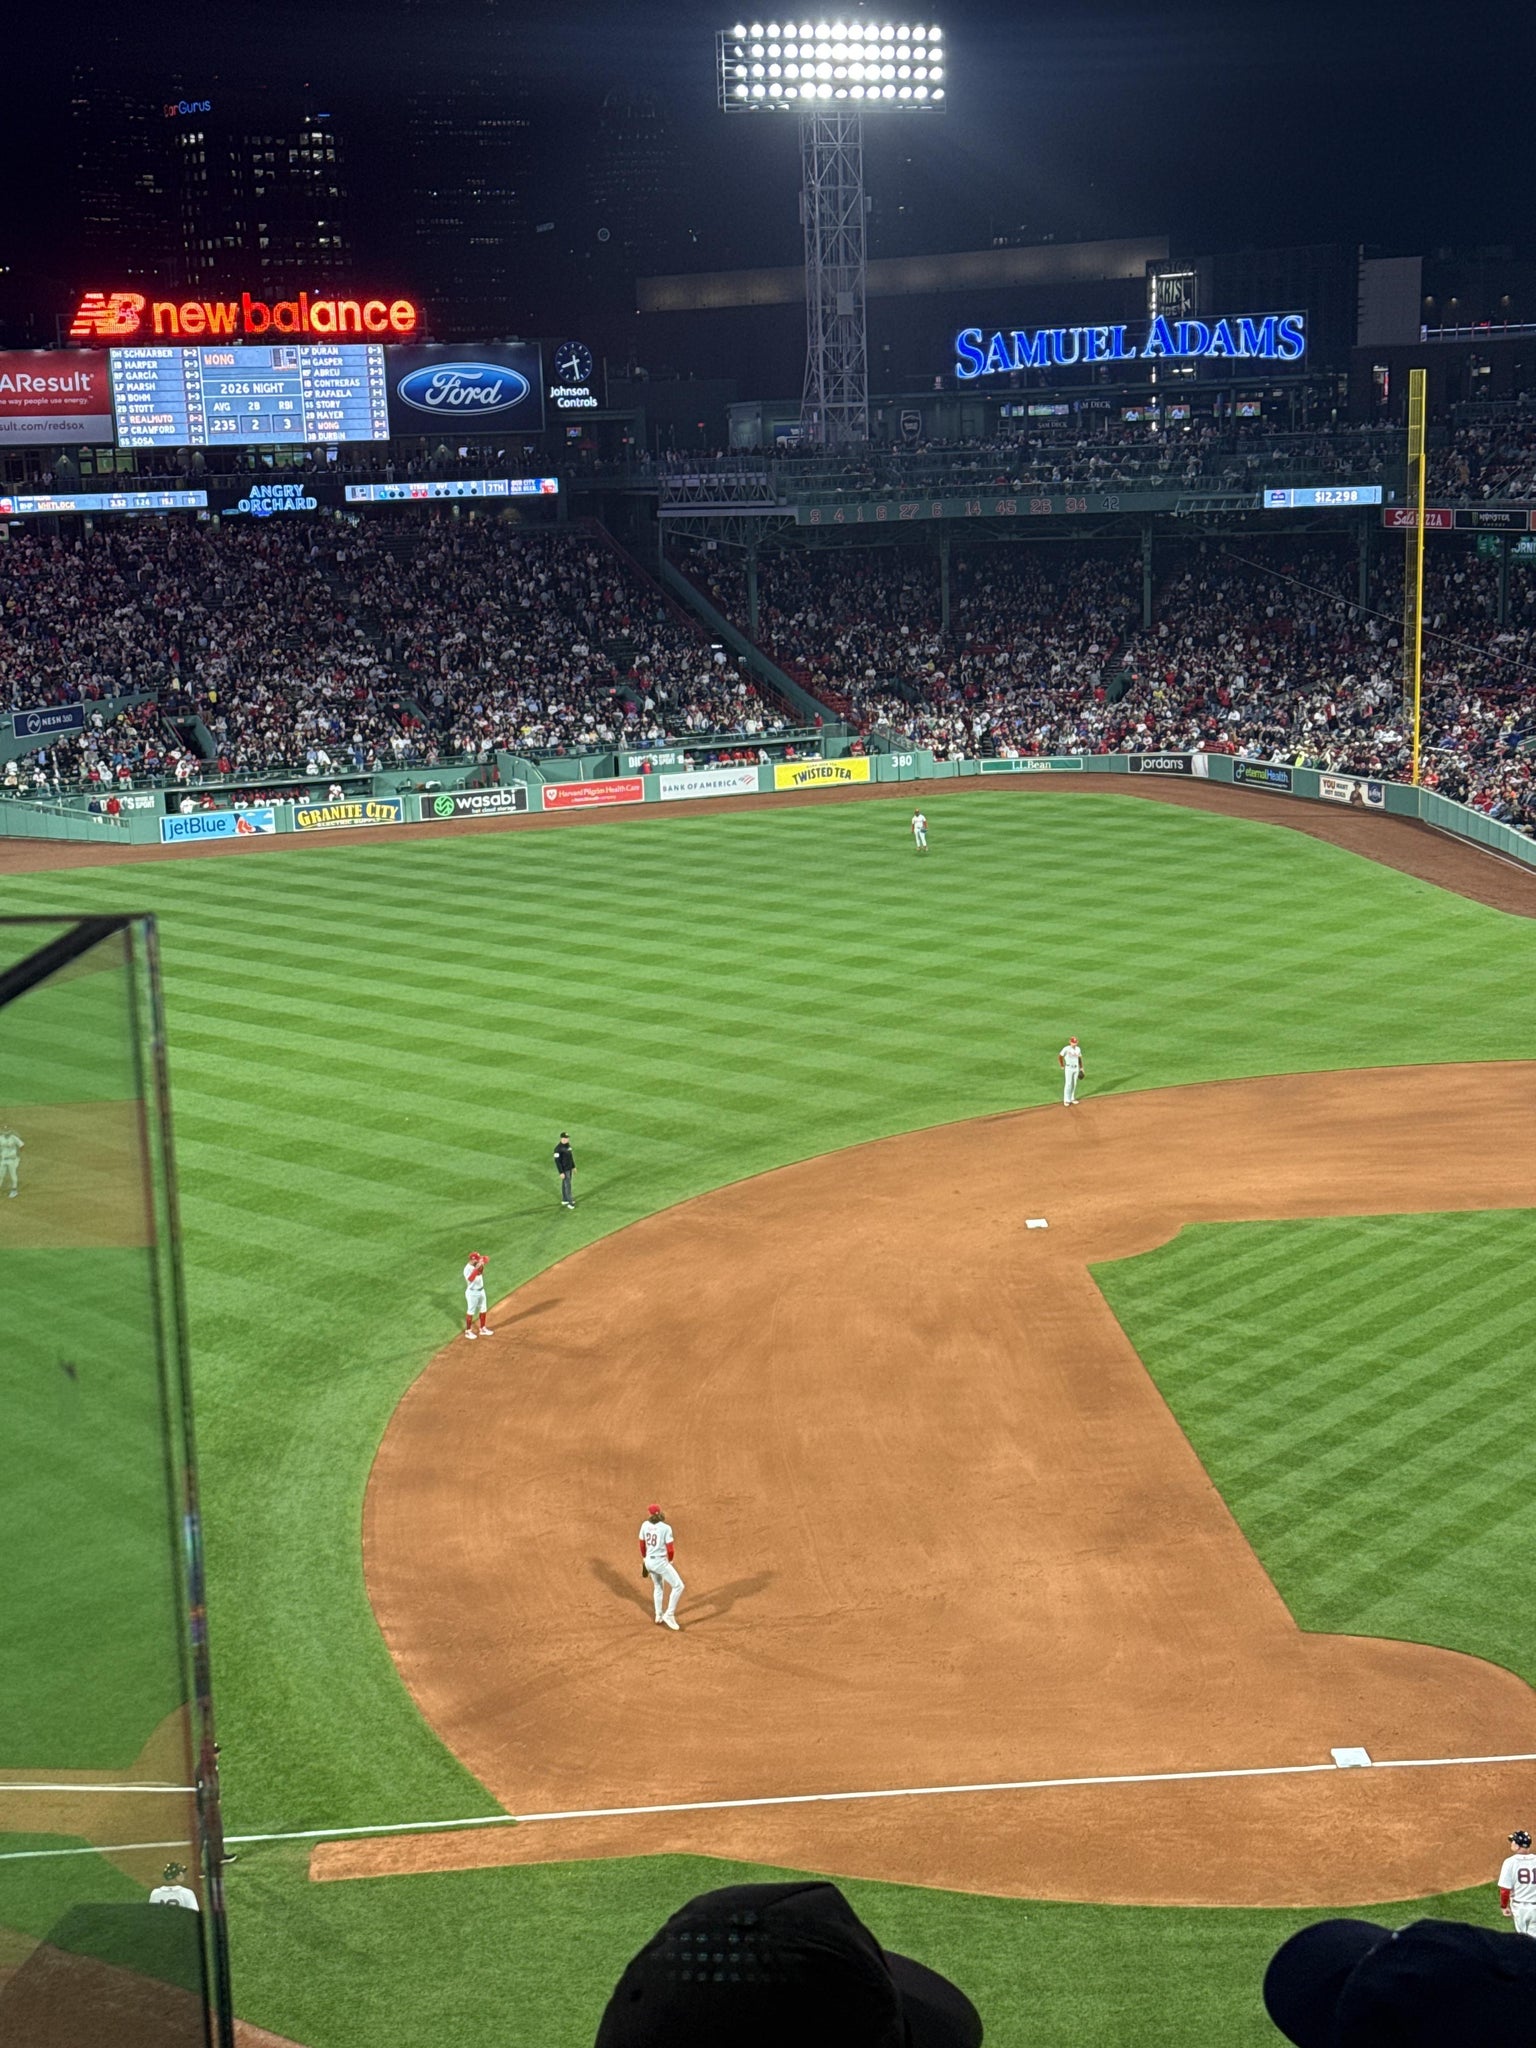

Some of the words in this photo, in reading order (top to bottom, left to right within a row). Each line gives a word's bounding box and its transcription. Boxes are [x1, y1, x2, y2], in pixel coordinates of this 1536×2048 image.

[164, 100, 211, 118] CarGurus
[153, 302, 238, 334] new
[242, 292, 415, 332] balance
[956, 326, 1137, 379] SAMUEL
[1141, 315, 1304, 361] ADAMS
[124, 350, 173, 358] SCHWARBER
[204, 354, 235, 365] WONG
[125, 361, 158, 369] HARPER
[312, 358, 343, 366] GASPER
[126, 370, 158, 380] GARCÍA
[127, 382, 155, 391] MARSH
[220, 383, 250, 394] 2026
[253, 382, 284, 393] NIGHT
[314, 379, 360, 387] CONTRERAS
[425, 371, 503, 405] Ford
[550, 386, 589, 398] Johnson
[24, 398, 48, 406] people
[213, 402, 231, 411] AVG
[248, 401, 260, 411] 2B
[279, 400, 293, 410] RBI
[557, 396, 598, 408] Controls
[129, 404, 154, 413] STOTT
[130, 415, 173, 423] REALMUTO
[316, 411, 344, 419] MAYER
[131, 426, 175, 434] CRAWFORD
[210, 419, 236, 431] .235
[252, 419, 259, 430] 2
[284, 419, 291, 429] 3
[318, 421, 339, 430] WONG
[132, 437, 154, 445] SOSA
[249, 484, 304, 498] ANGRY
[488, 484, 504, 492] 7TH
[1314, 490, 1358, 504] $12,298
[238, 497, 317, 512] ORCHARD
[834, 508, 845, 523] 4
[857, 506, 864, 522] 1
[900, 504, 919, 520] 27
[964, 501, 981, 516] 14
[995, 499, 1017, 515] 45
[1066, 497, 1087, 513] 34
[1102, 496, 1120, 512] 42
[1415, 514, 1443, 526] PZZA
[42, 716, 61, 726] NESN
[63, 714, 73, 723] 360
[891, 755, 912, 768] 380
[792, 766, 833, 785] TWISTED
[834, 767, 852, 780] TEA
[1246, 767, 1289, 783] eternalHealth
[662, 784, 686, 792] BANK
[700, 779, 737, 789] AMERICA
[1322, 779, 1336, 789] YOU
[456, 789, 515, 809] wasabi
[559, 789, 583, 798] Harvard
[583, 788, 605, 797] Pilgrim
[297, 804, 362, 827] GRANITE
[366, 802, 399, 820] CITY
[169, 817, 226, 839] jetBlue
[646, 1532, 657, 1547] 28
